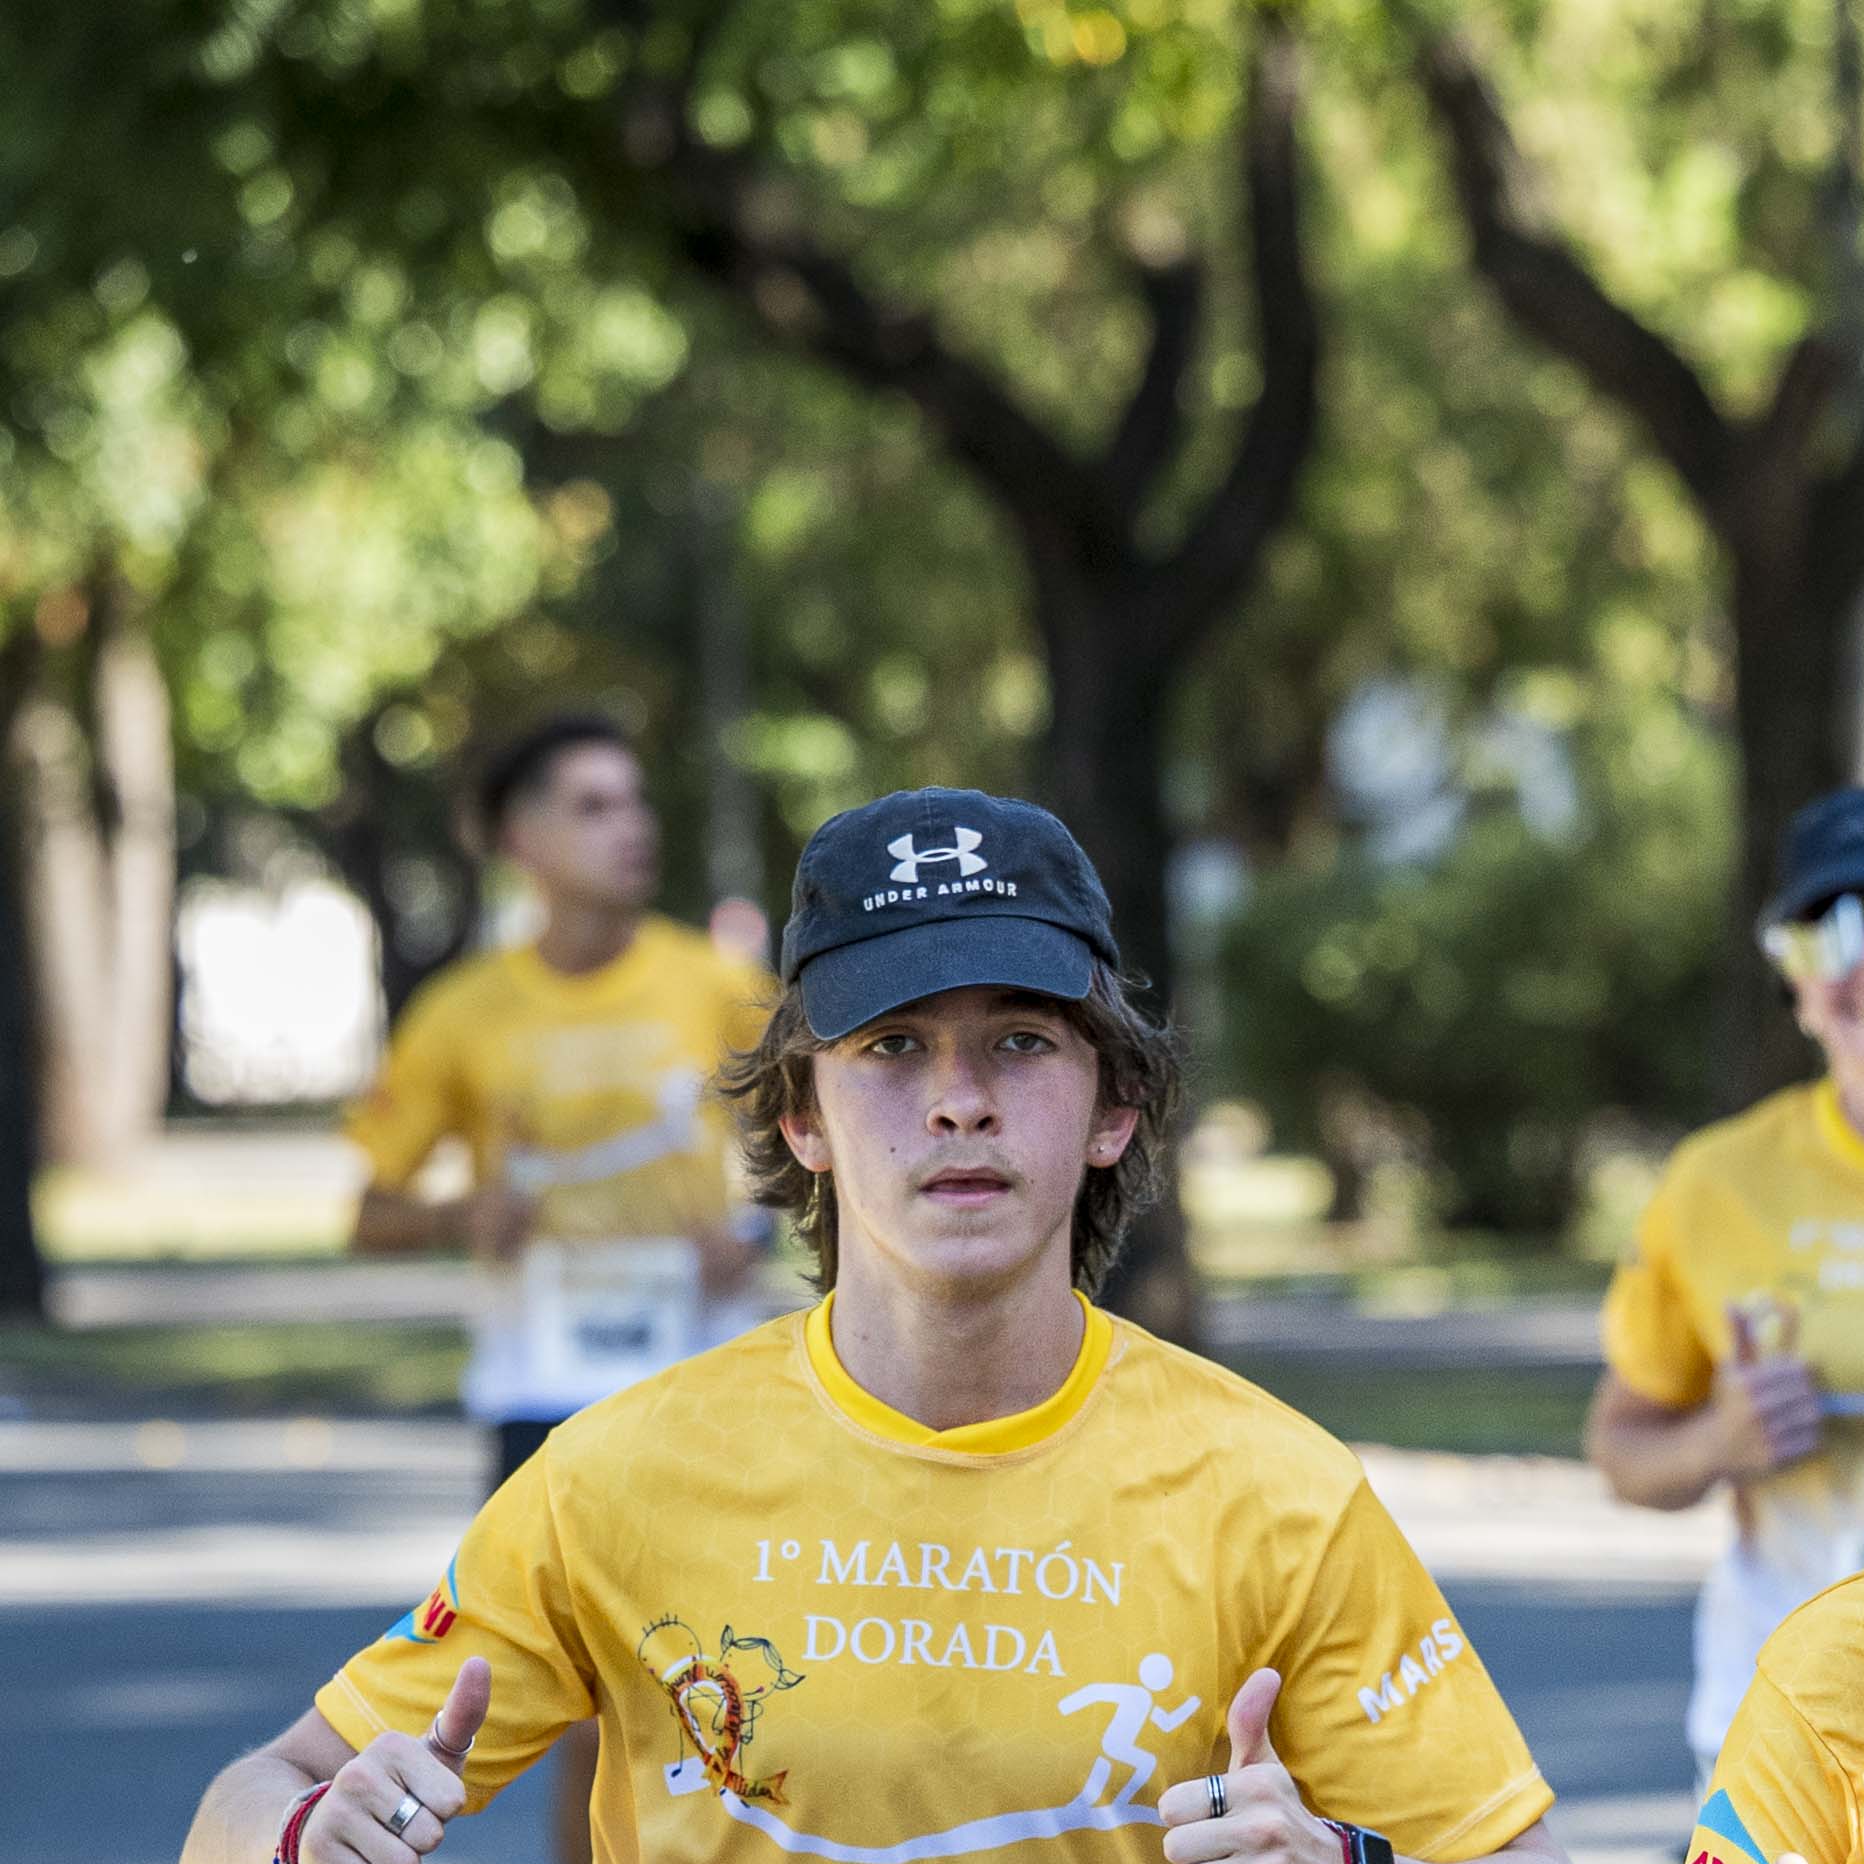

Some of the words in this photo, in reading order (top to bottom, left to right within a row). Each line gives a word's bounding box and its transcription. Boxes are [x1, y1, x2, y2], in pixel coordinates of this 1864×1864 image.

[863, 885, 928, 912] UNDER
[936, 877, 1018, 898] ARMOUR
[815, 1539, 1125, 1607] MARATÓN
[801, 1613, 1068, 1678] DORADA
